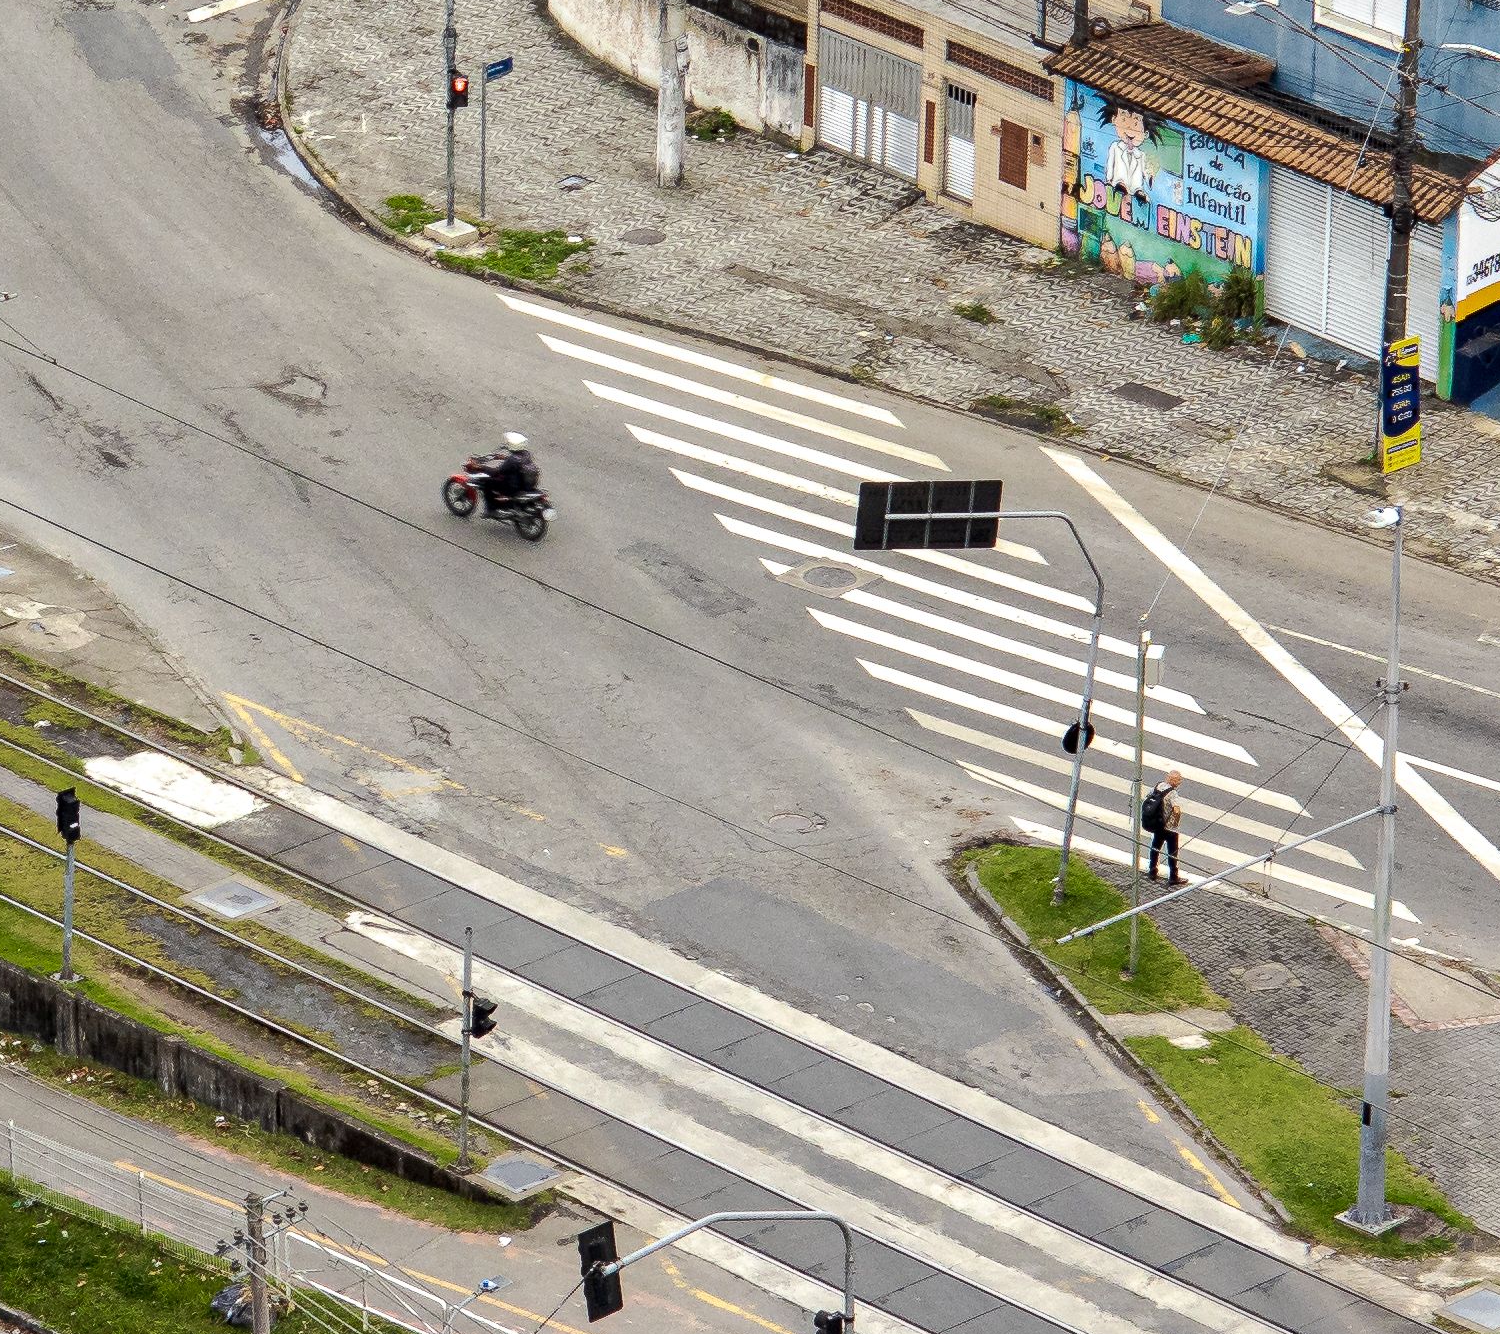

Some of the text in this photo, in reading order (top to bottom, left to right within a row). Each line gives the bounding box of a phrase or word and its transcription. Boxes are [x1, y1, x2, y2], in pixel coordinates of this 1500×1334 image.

[1189, 133, 1246, 169] ESCOLA
[1208, 154, 1224, 172] de
[1077, 173, 1151, 231] JOVEM
[1186, 163, 1252, 203] Educação
[1186, 186, 1247, 226] Infantil
[1156, 203, 1253, 269] EINSTEIN
